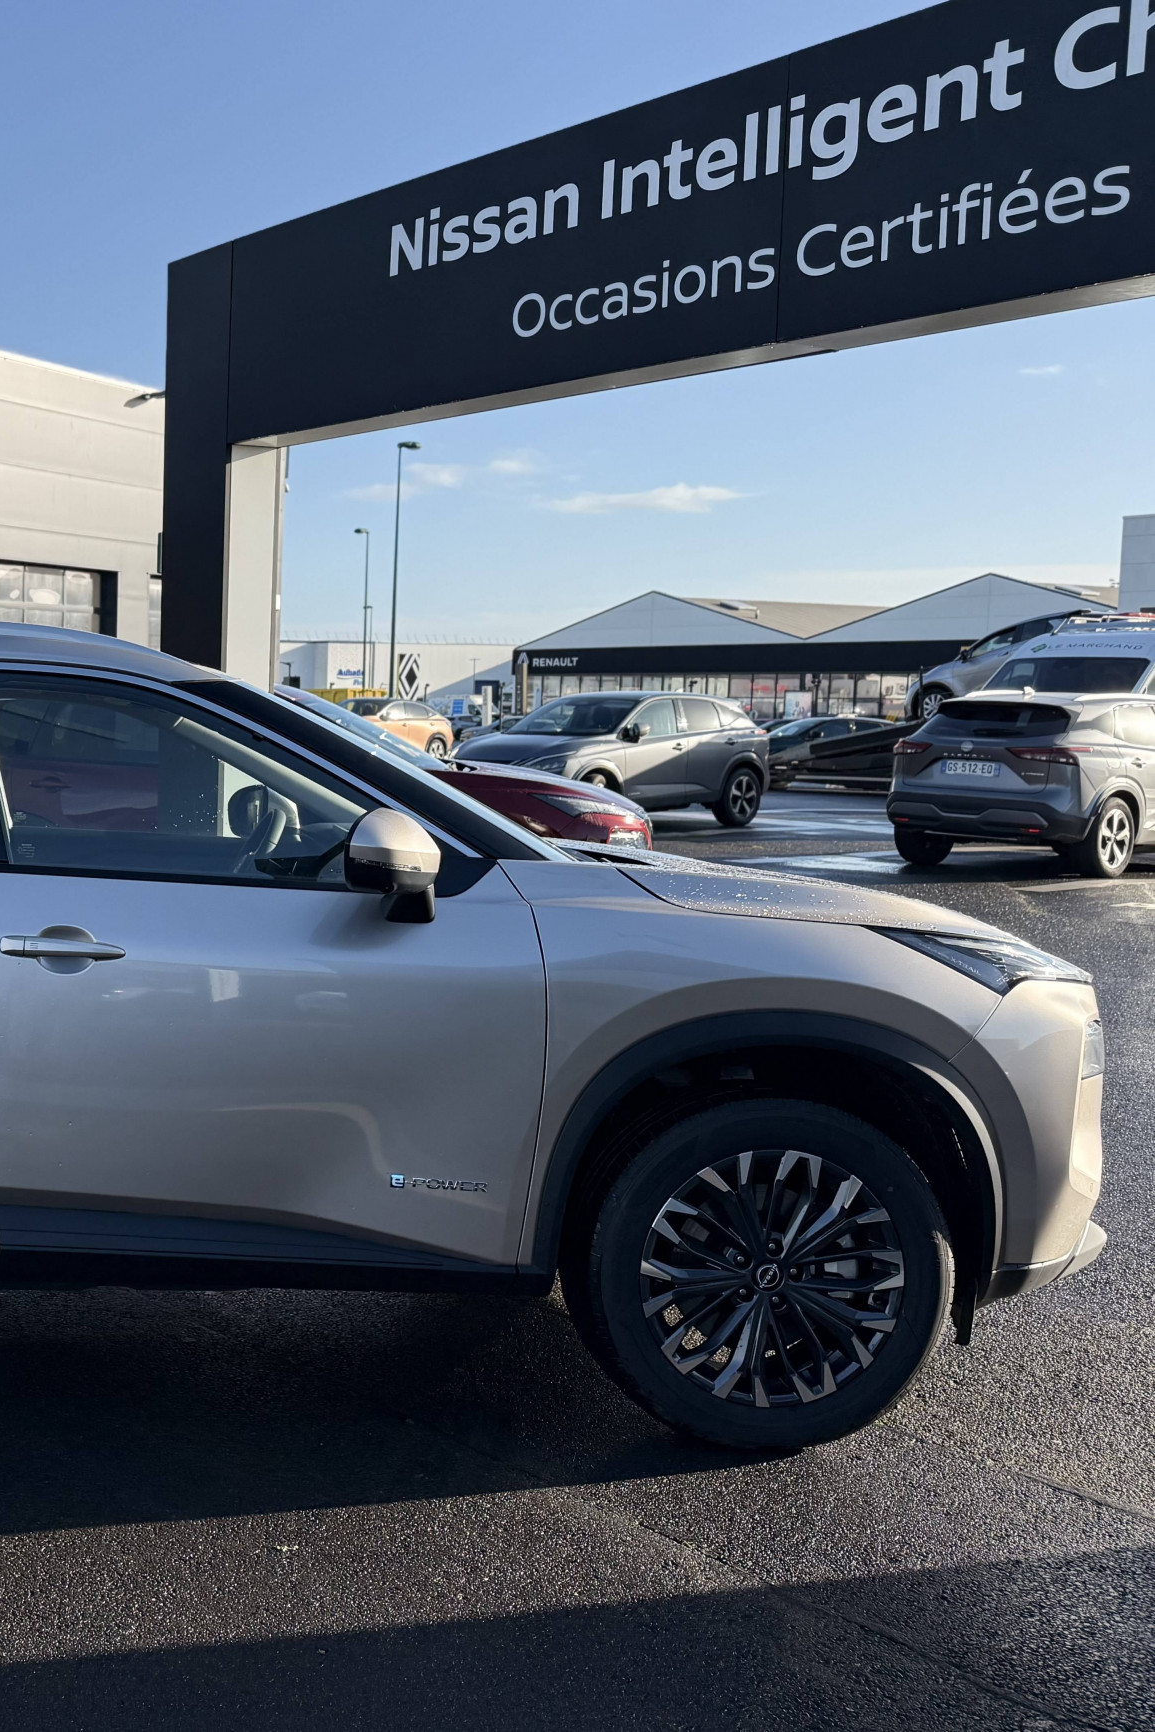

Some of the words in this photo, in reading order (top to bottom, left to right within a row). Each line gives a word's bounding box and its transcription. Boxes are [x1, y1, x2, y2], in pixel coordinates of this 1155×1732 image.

[389, 182, 580, 278] Nissan
[601, 38, 1026, 220] Intelligent
[512, 247, 775, 338] Occasions
[796, 165, 1131, 277] Certifiées
[1067, 642, 1144, 651] MARCHAND
[532, 656, 579, 667] RENAULT
[336, 668, 365, 677] Aubad
[759, 1263, 778, 1289] NISSAN
